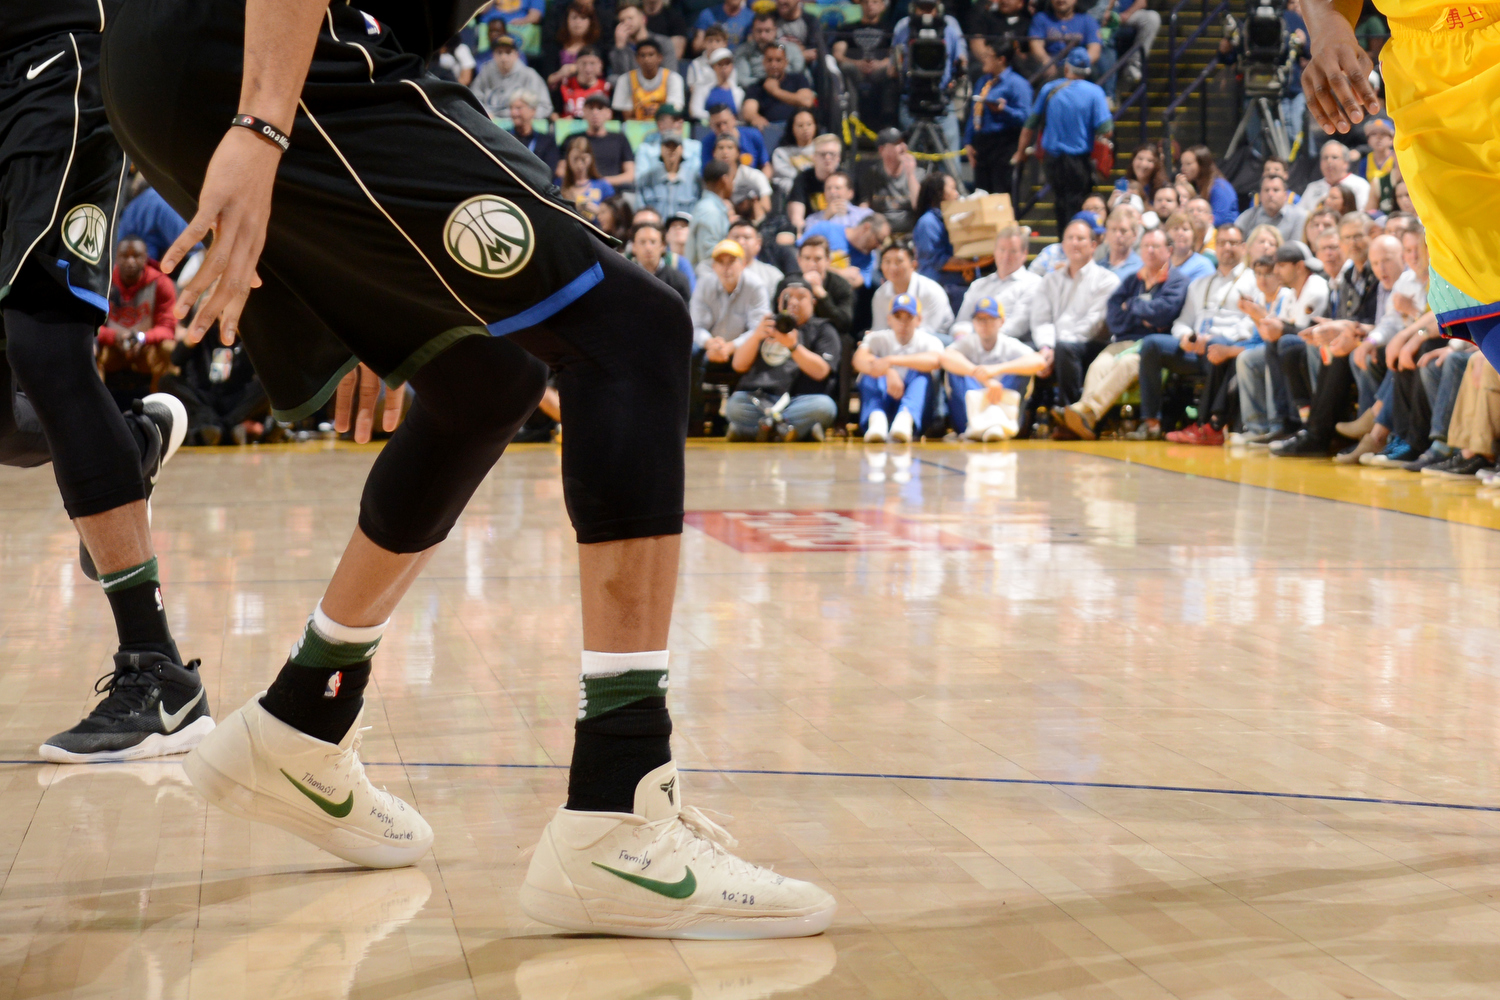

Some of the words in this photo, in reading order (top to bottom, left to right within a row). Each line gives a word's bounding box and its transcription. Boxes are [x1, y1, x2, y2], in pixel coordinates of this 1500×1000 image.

[1446, 6, 1484, 30] 勇士
[383, 828, 414, 841] Charles
[618, 849, 653, 871] Family
